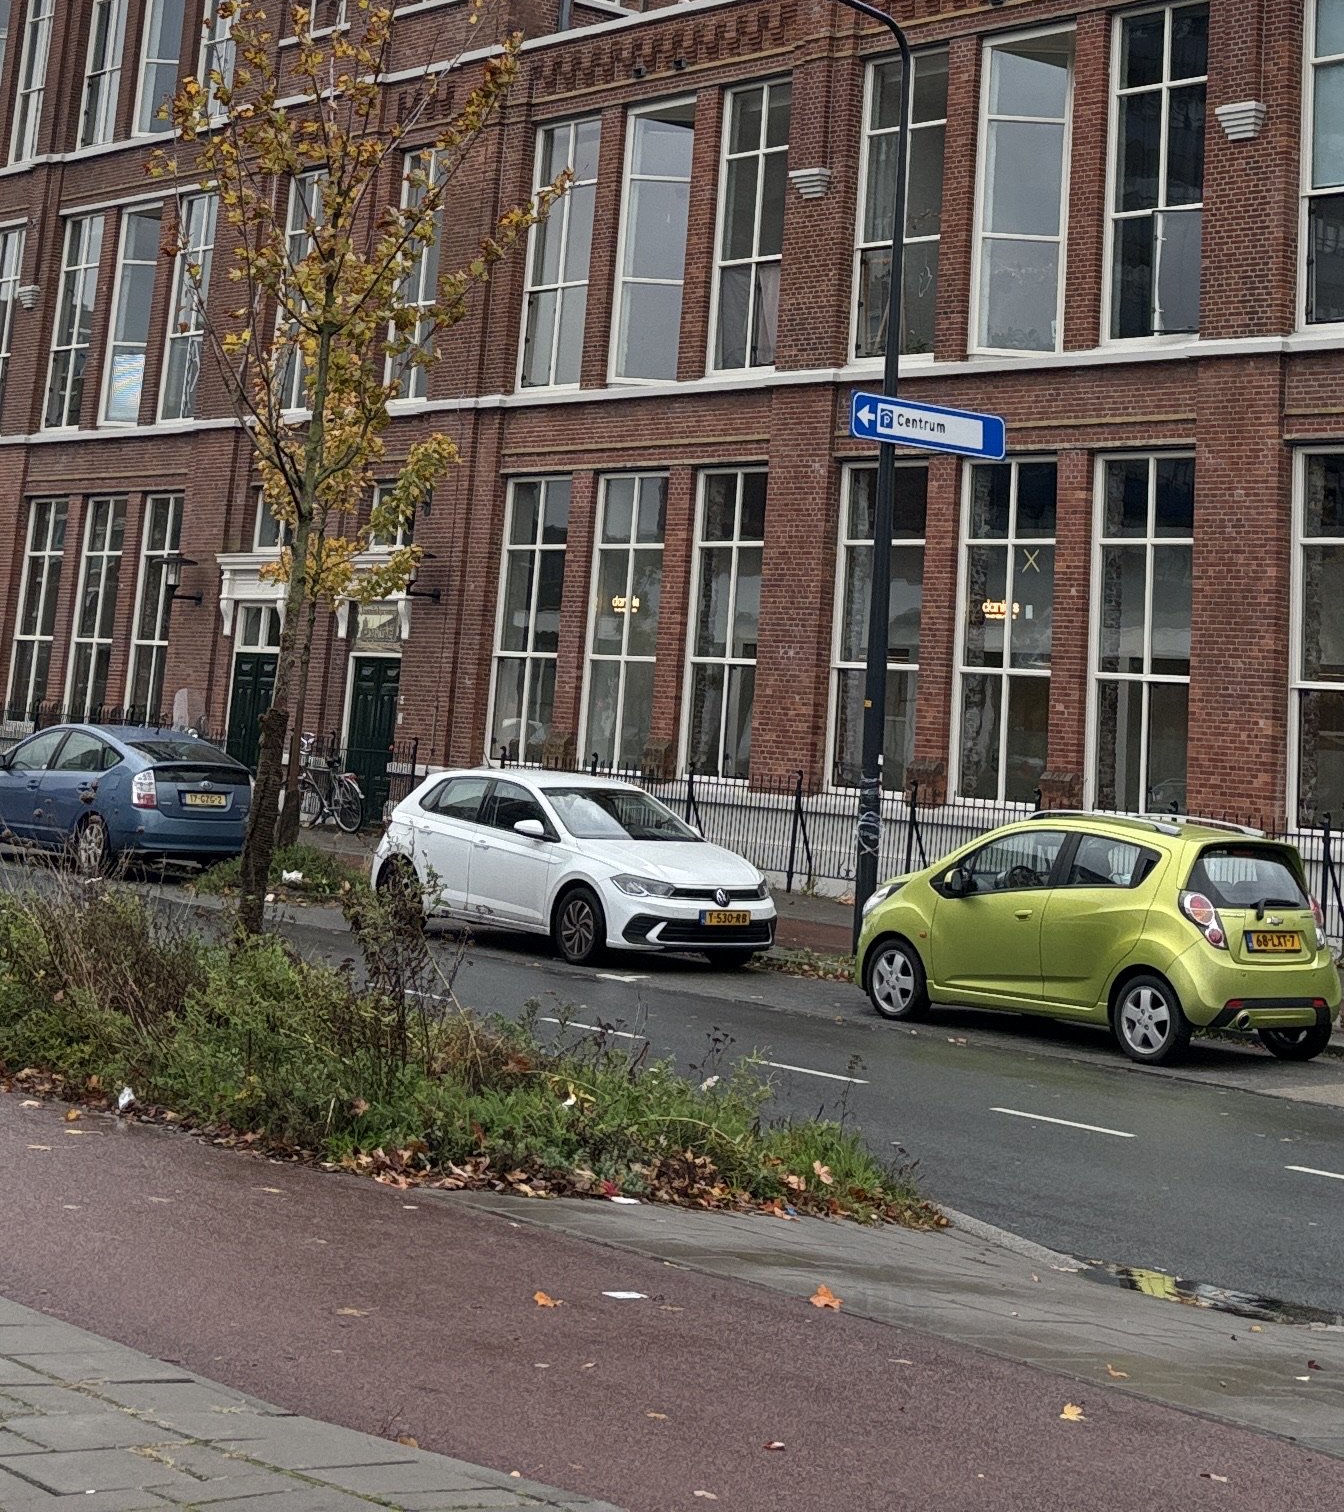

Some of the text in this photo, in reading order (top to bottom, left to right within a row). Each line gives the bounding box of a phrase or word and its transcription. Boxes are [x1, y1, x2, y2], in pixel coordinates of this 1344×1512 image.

[897, 413, 946, 434] Centrum
[708, 912, 748, 925] T-530-RB
[1256, 934, 1295, 948] 68-LXT-7
